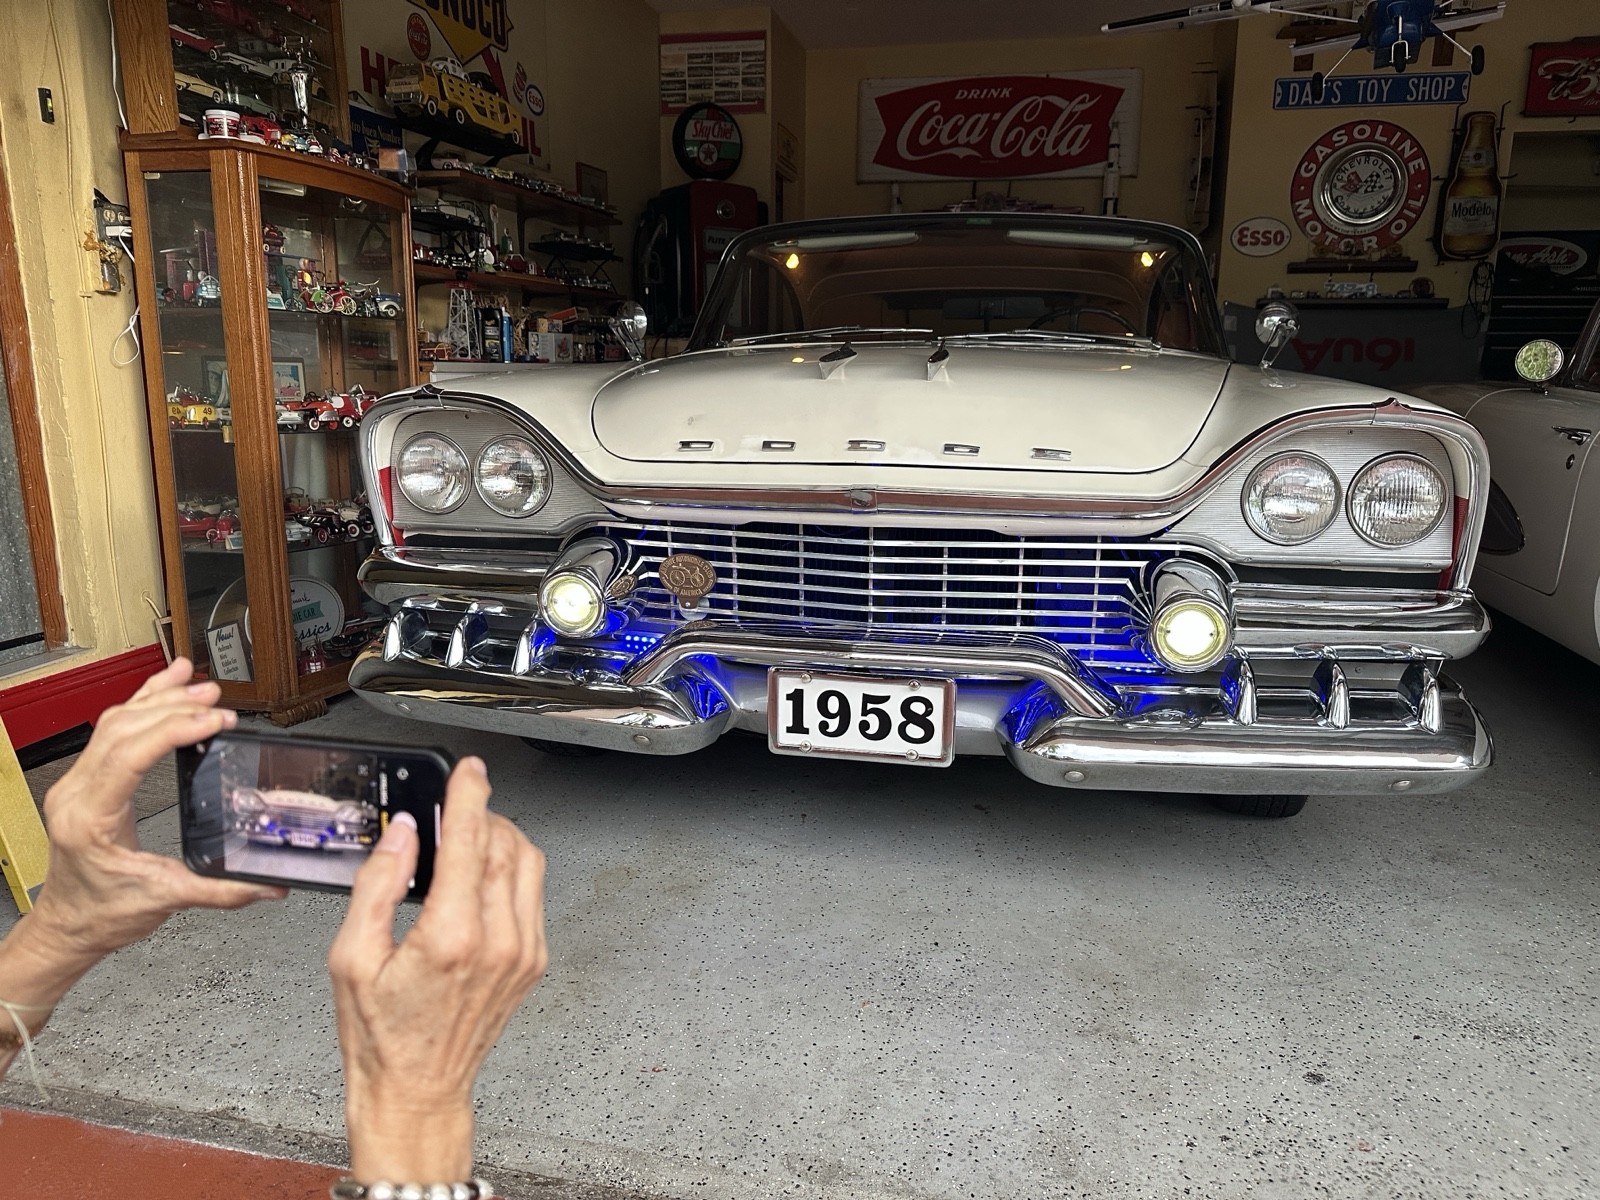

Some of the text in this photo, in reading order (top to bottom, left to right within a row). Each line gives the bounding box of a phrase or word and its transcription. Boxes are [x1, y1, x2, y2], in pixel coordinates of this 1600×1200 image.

[954, 86, 1013, 101] DRINK
[1357, 78, 1393, 103] TOY
[1406, 76, 1456, 101] SHOP
[692, 120, 735, 141] Sky Chief
[896, 93, 1102, 161] Coca-Cola
[1299, 123, 1426, 178] GASOLINE
[1335, 156, 1393, 182] CHEVROLET
[1451, 202, 1491, 217] Modelo
[1294, 194, 1425, 252] MOTOR OIL
[1236, 227, 1286, 247] Esso
[203, 406, 212, 415] 49
[702, 563, 714, 579] CLUB
[303, 607, 316, 619] CAR
[215, 626, 234, 646] New!
[785, 688, 935, 745] 1958
